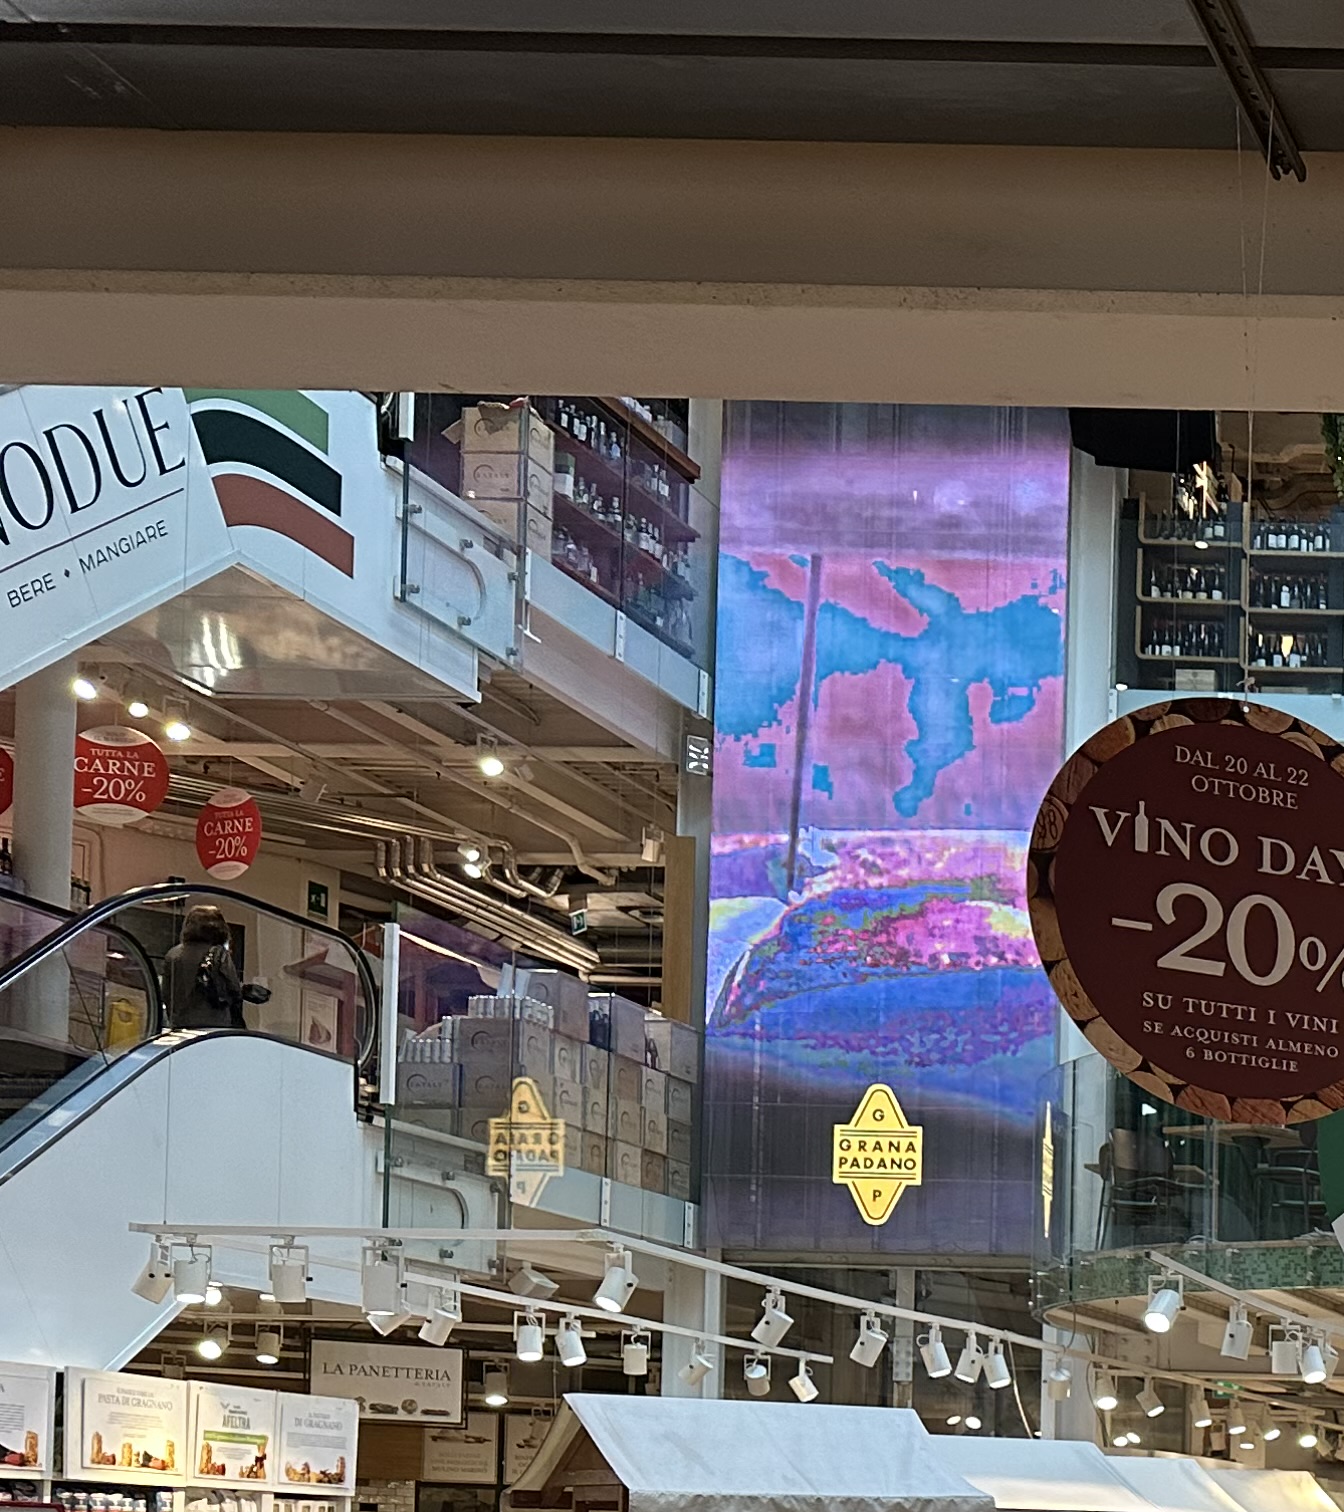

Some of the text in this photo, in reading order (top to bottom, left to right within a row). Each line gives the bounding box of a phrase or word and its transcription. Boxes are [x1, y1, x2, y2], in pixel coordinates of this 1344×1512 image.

[0, 386, 186, 546] ODUE
[7, 520, 169, 608] BERE MANGIARE
[74, 756, 156, 778] CARNE
[1174, 745, 1310, 787] DAL 20 AL 22
[81, 777, 146, 803] -20%
[1191, 774, 1300, 811] OTTOBRE
[1088, 799, 1241, 868] VINO
[1141, 990, 1340, 1035] SU TUTTI I VINI
[1141, 1019, 1340, 1059] SE ACQUISTI ALMENO
[1184, 1045, 1300, 1073] 6 BOTTIGLIE
[838, 1156, 917, 1171] PADANO
[839, 1138, 917, 1153] GRANA
[322, 1362, 452, 1382] LA PANETTERIA
